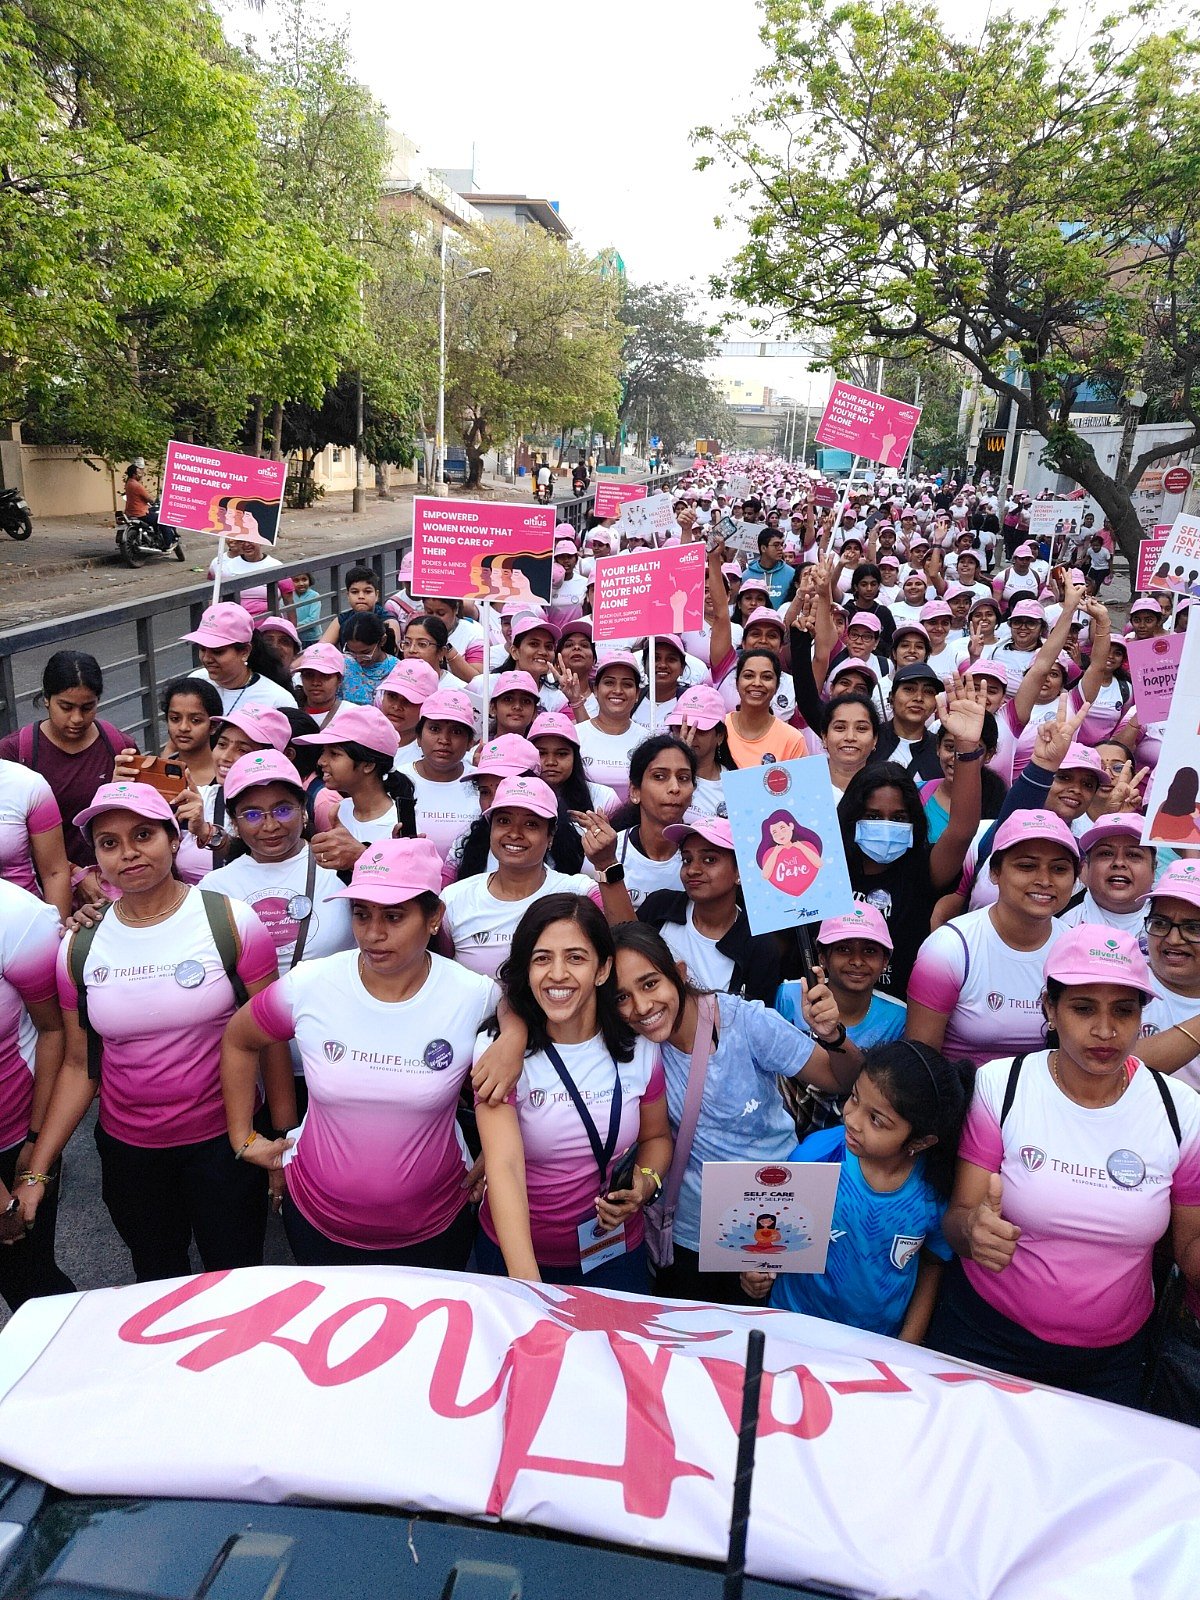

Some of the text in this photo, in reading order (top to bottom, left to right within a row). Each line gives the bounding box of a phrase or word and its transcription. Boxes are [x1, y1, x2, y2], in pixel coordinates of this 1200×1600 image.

[834, 398, 876, 418] MATTERS, &
[837, 390, 885, 412] YOUR HEALTH
[828, 414, 852, 427] ALONE
[832, 406, 873, 425] YOU'RE NOT
[174, 452, 220, 466] EMPOWERED
[173, 462, 248, 482] WOMEN KNOW THAT
[258, 467, 278, 478] altius
[172, 473, 232, 490] TAKING CARE OF
[171, 484, 192, 494] THEIR
[422, 510, 478, 522] EMPOWERED
[524, 517, 547, 527] altius
[423, 522, 458, 532] WOMEN
[460, 526, 488, 534] KNOW
[490, 528, 513, 536] THAT
[1180, 526, 1200, 538] SEL
[422, 534, 494, 547] TAKING CARE OF
[1176, 534, 1200, 550] ISN'
[422, 547, 446, 556] THEIR
[1172, 545, 1192, 557] IT'S
[428, 568, 456, 576] ESSENTIAL
[602, 561, 660, 577] YOUR HEALTH
[601, 574, 652, 588] MATTERS, &
[600, 584, 652, 598] YOU'RE NOT
[600, 598, 628, 610] ALONE
[422, 811, 456, 819] TRILIFE
[783, 856, 798, 866] Self
[776, 862, 810, 882] Care
[1089, 948, 1132, 964] SilverLine
[113, 964, 155, 978] TRILIFE
[350, 1050, 402, 1066] TRILIFE
[1052, 1158, 1106, 1180] TRILIFE
